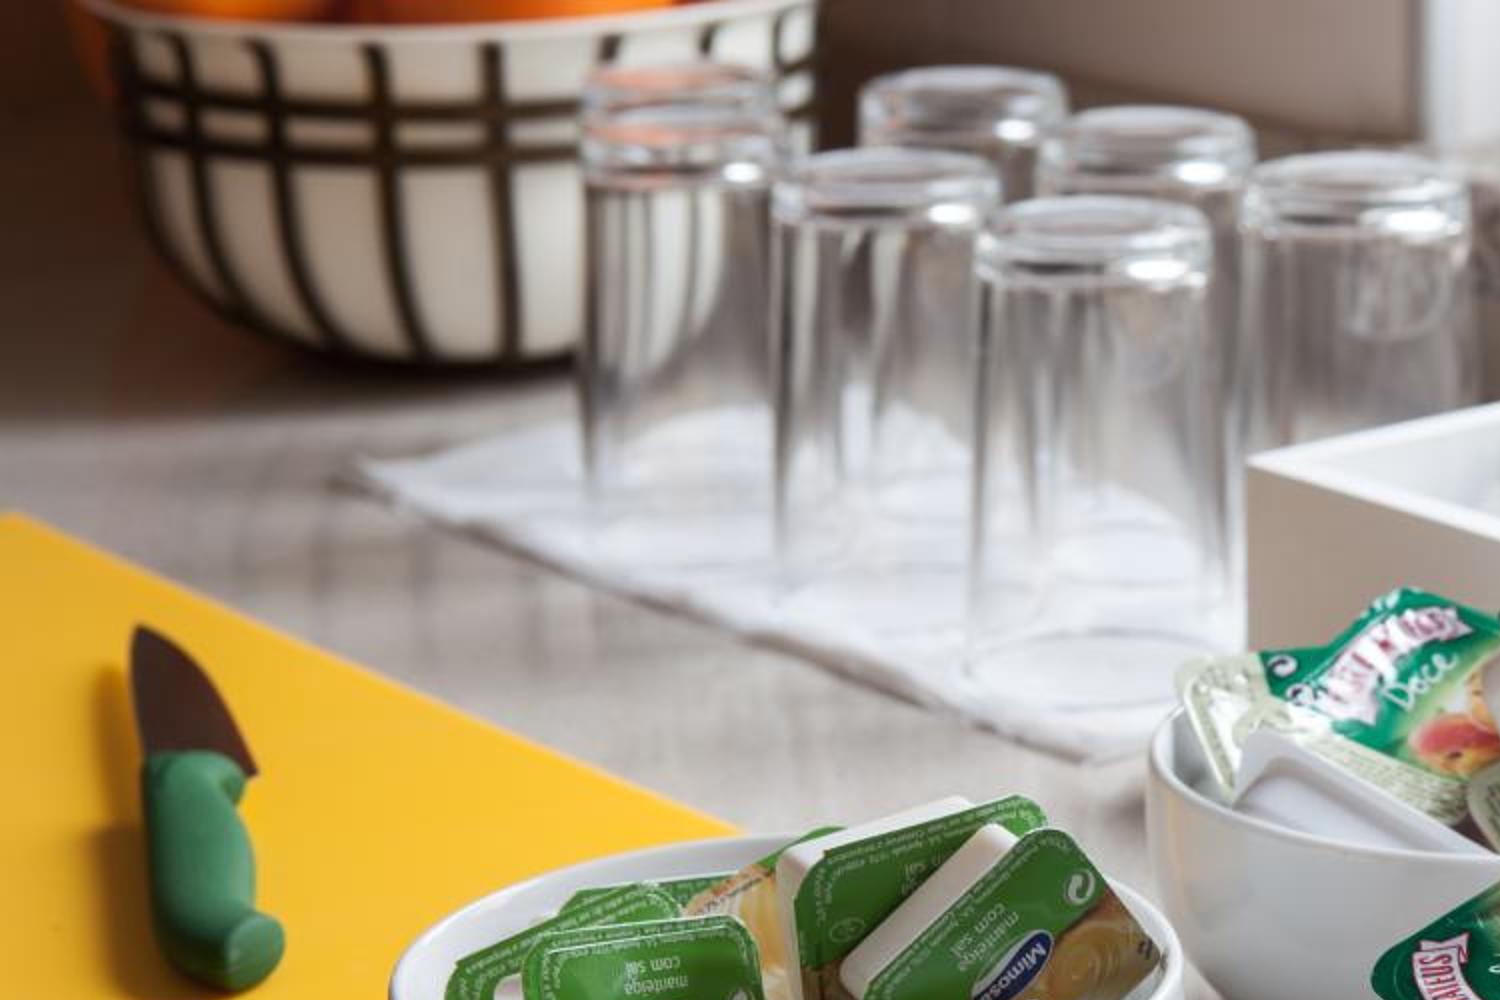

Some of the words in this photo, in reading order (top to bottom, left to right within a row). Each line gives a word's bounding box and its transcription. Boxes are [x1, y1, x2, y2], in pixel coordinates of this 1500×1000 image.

[1384, 652, 1459, 711] Doce
[649, 956, 681, 972] com
[624, 975, 689, 996] manteiga
